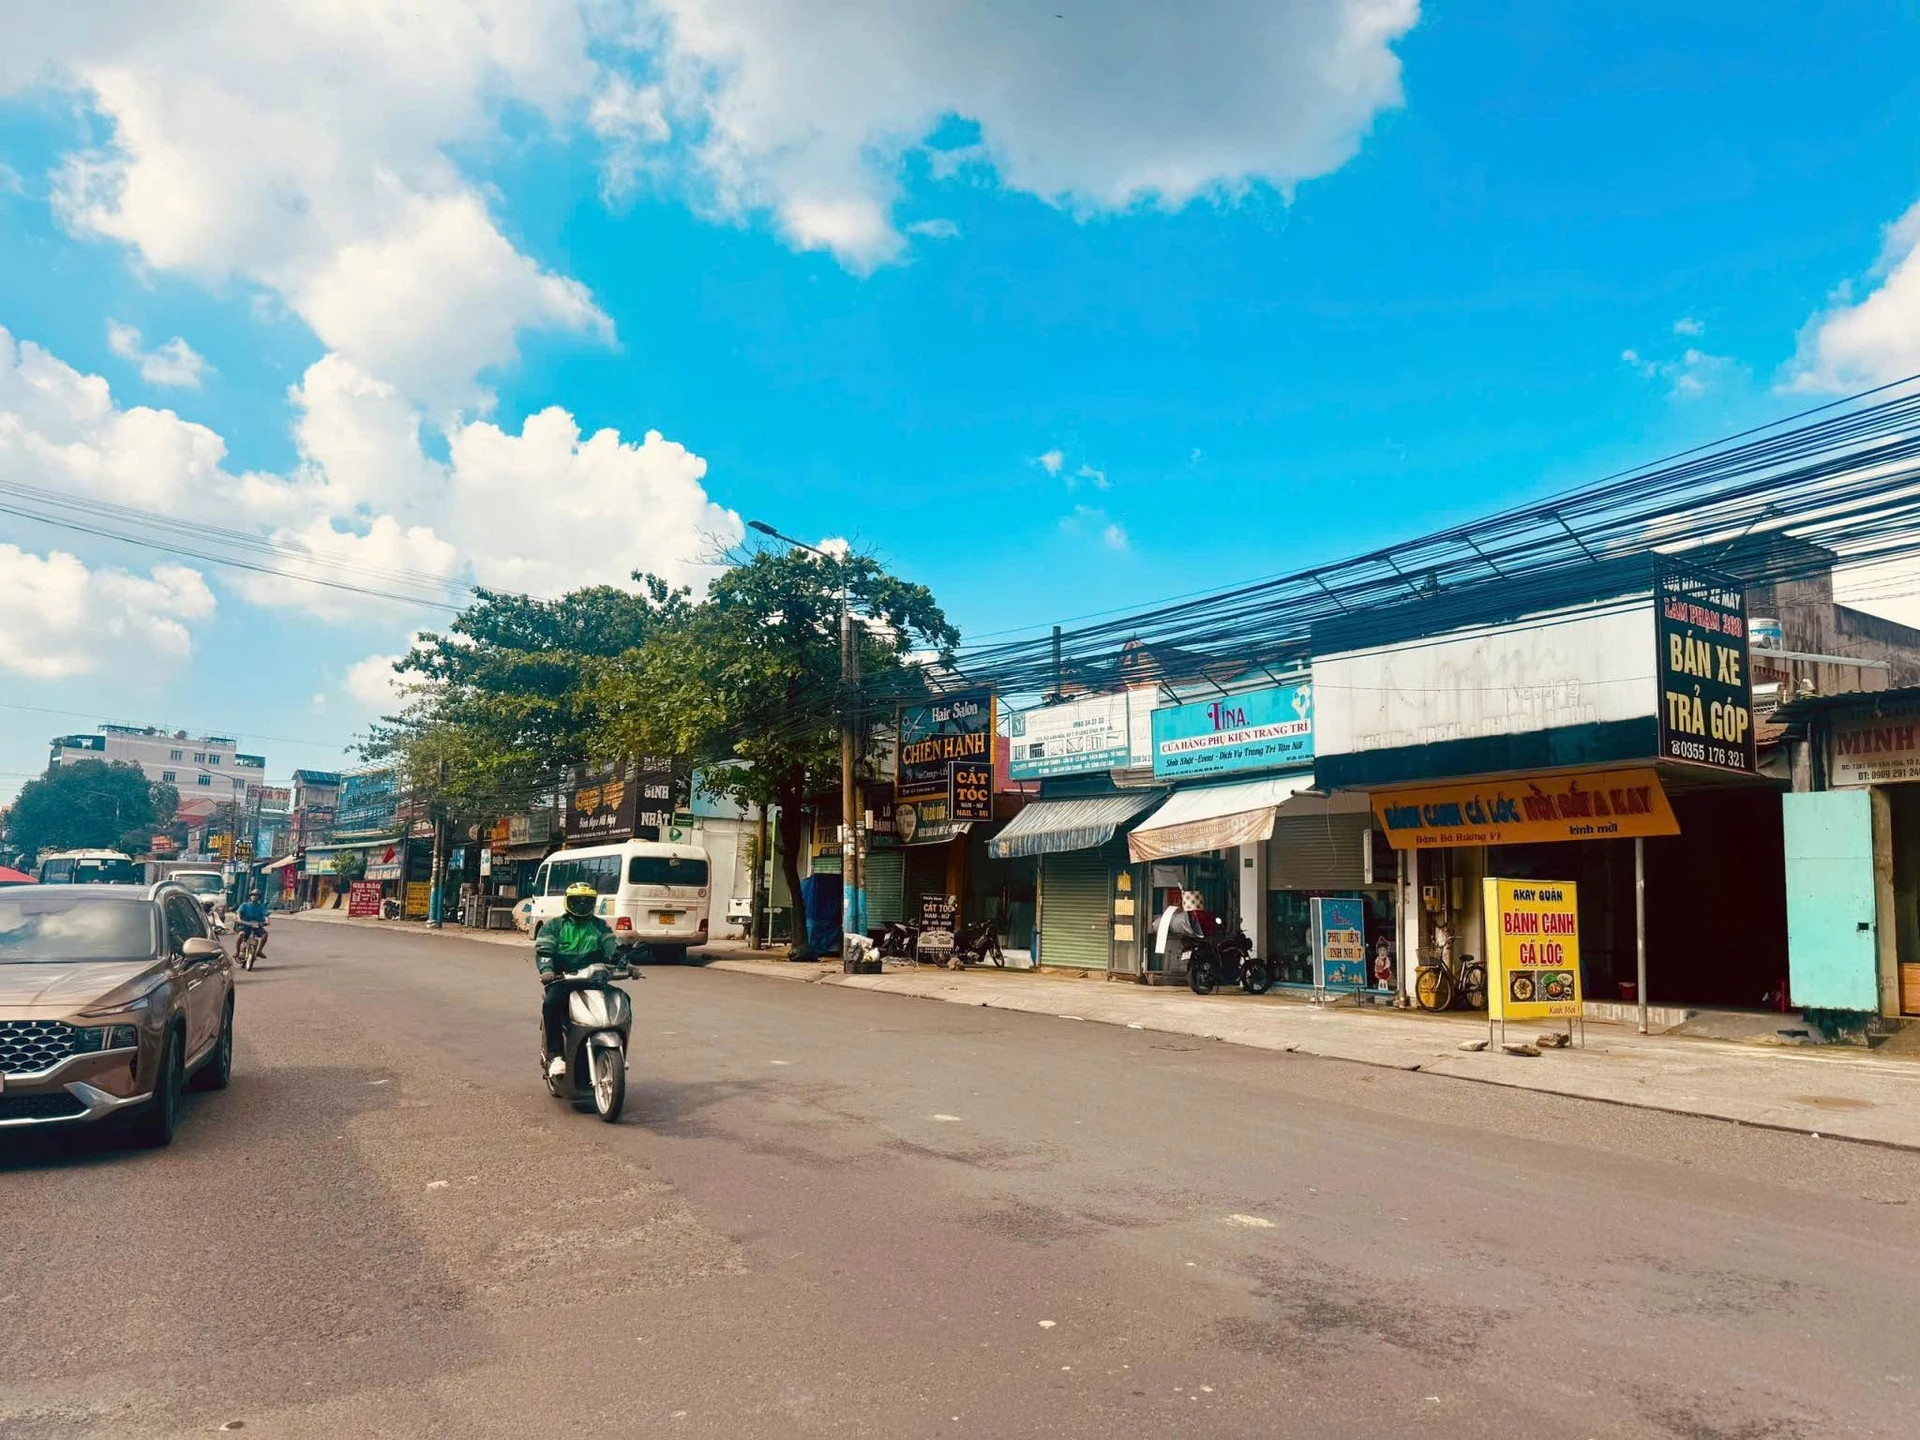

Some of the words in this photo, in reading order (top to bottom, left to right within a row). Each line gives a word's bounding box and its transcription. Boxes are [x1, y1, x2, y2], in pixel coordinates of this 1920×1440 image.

[1722, 587, 1741, 612] MÁY
[1689, 604, 1720, 633] PHẠM
[1669, 629, 1712, 680] BÁN
[1716, 645, 1741, 687] XE
[932, 707, 951, 723] Hair
[953, 700, 978, 718] Salon
[1666, 684, 1706, 737] TRẢ
[1710, 697, 1749, 744] GÓP
[902, 733, 942, 765] CHIẾN
[944, 732, 985, 761] HẠNH
[1162, 741, 1180, 753] CỬA
[1181, 738, 1206, 750] HÀNG
[1208, 734, 1225, 746] PHỤ
[1228, 732, 1251, 744] KIỆN
[1253, 725, 1288, 739] TRANG
[1291, 719, 1309, 733] TRÍ
[1837, 725, 1916, 756] MINH
[1166, 759, 1179, 767] Sinh
[1179, 756, 1194, 767] Nhật
[1244, 747, 1264, 757] Trang
[1680, 741, 1705, 760] 0355
[1708, 746, 1726, 765] 176
[1728, 751, 1745, 768] 321
[956, 766, 988, 785] CẮT
[956, 785, 988, 801] TÓC
[641, 809, 670, 829] NHẬT
[1513, 889, 1536, 901] AKAY
[1538, 888, 1563, 901] QUÁN
[1503, 908, 1539, 935] BÁNH
[1541, 912, 1575, 935] CANH
[1327, 931, 1342, 945] PHỤ
[1519, 939, 1538, 966] CÁ
[1540, 939, 1564, 966] LÓC
